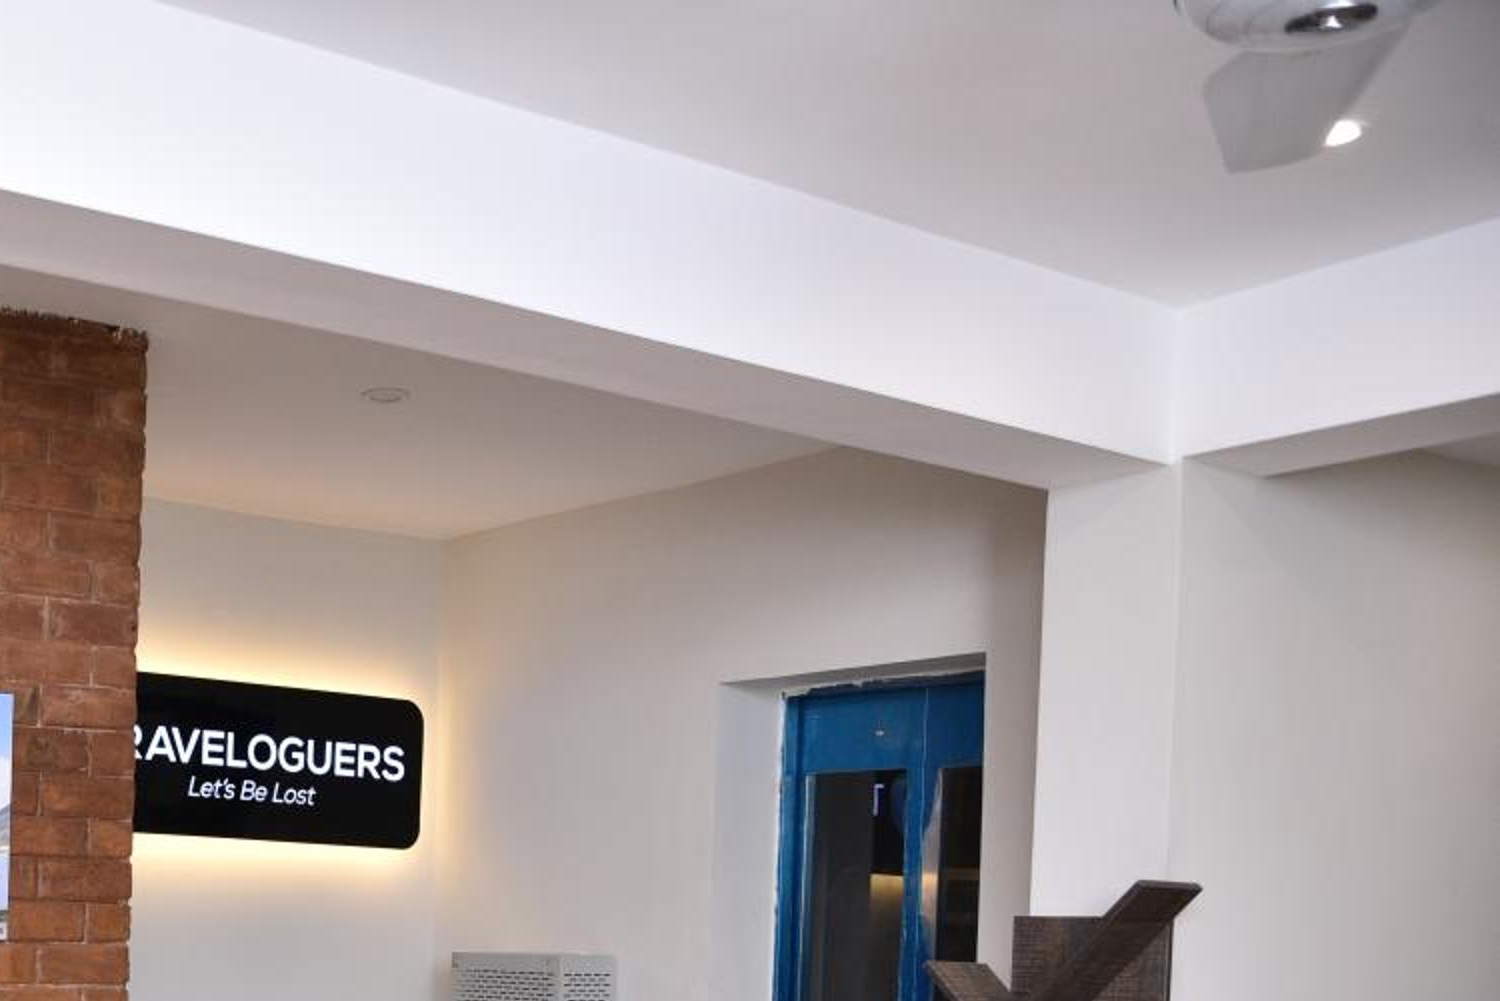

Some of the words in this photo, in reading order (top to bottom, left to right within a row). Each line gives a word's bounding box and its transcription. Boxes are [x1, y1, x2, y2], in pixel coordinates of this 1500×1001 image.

[187, 776, 236, 800] Let's
[240, 779, 268, 802] Be
[272, 782, 317, 806] Lost
